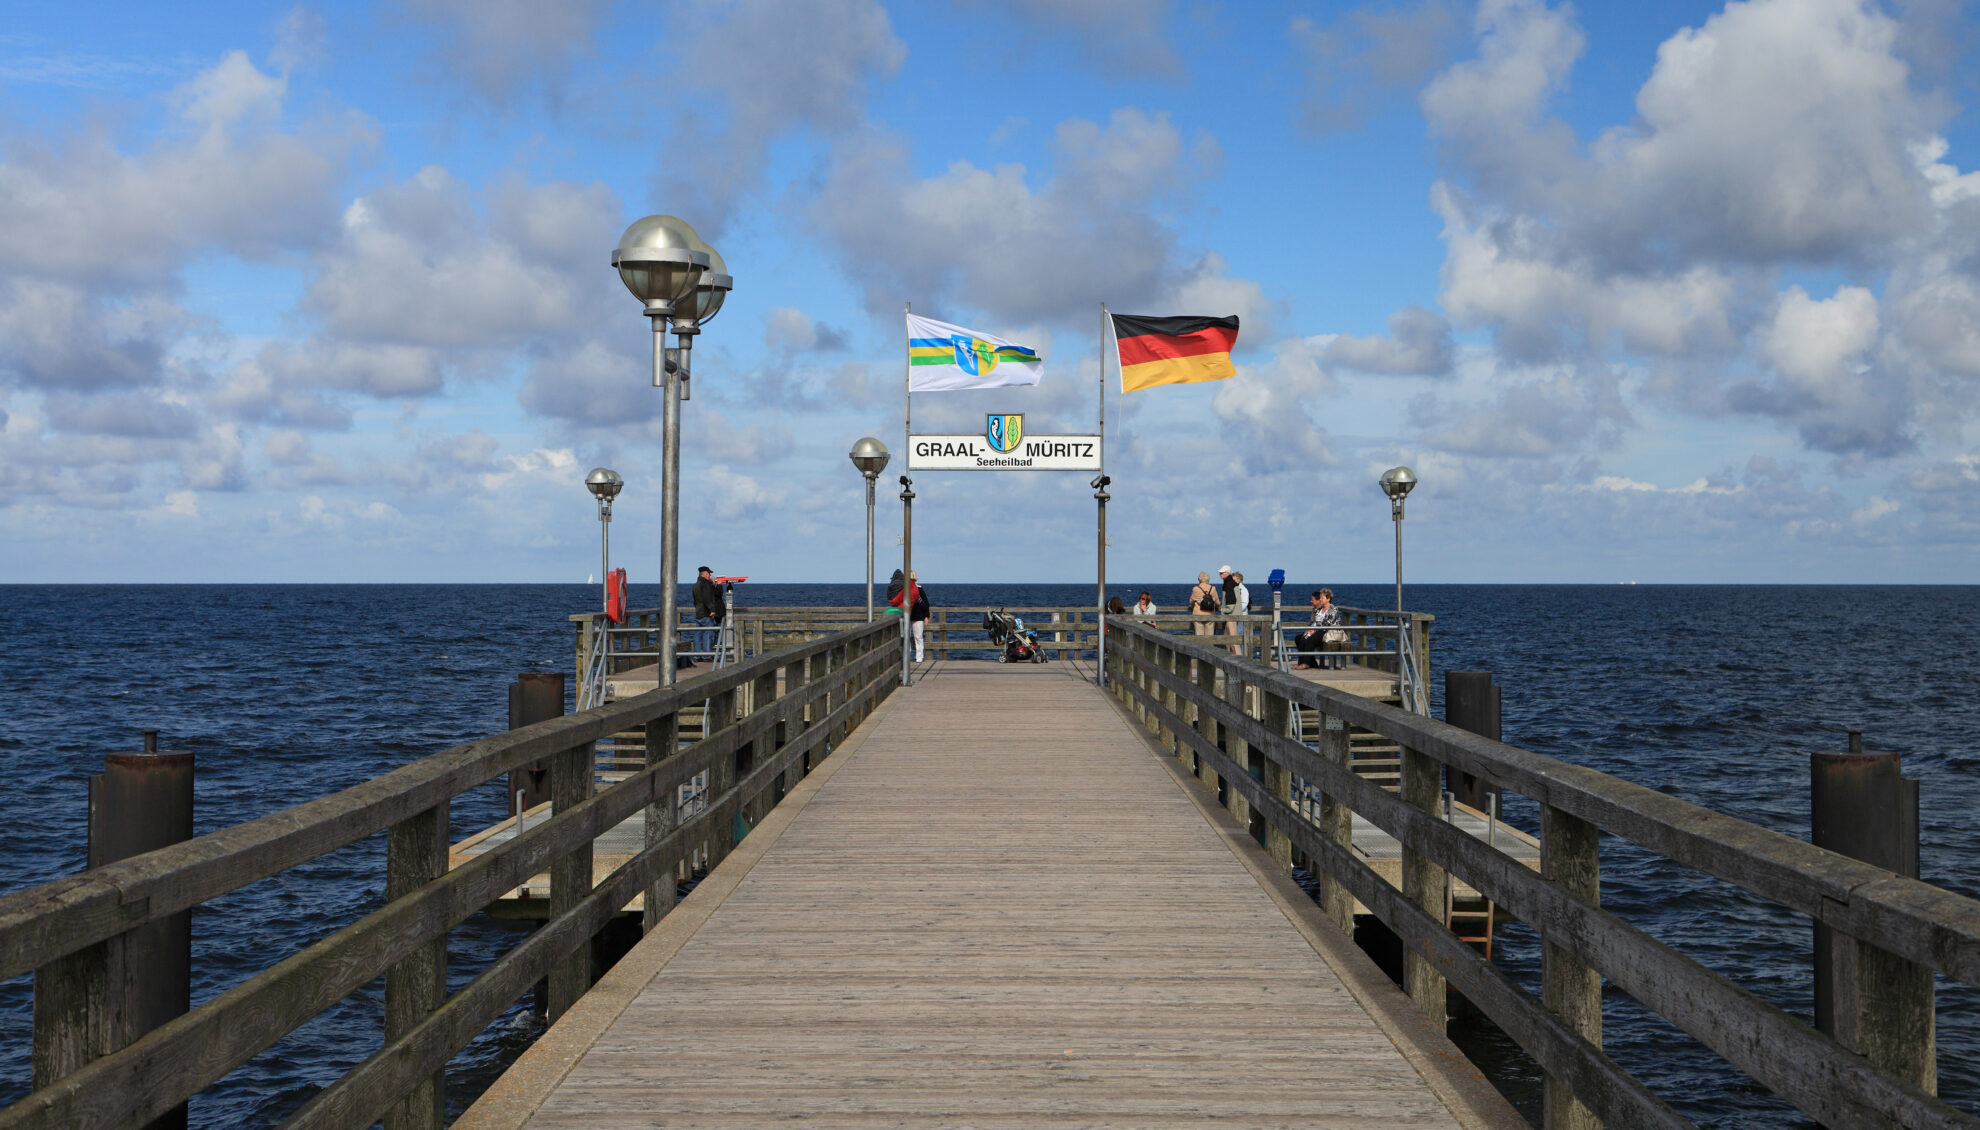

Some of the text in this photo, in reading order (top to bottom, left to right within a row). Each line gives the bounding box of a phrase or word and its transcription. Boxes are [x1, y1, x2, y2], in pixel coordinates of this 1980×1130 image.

[916, 440, 1094, 458] GRAAL- MÜRITZ
[976, 457, 1033, 467] Seeheilbad
